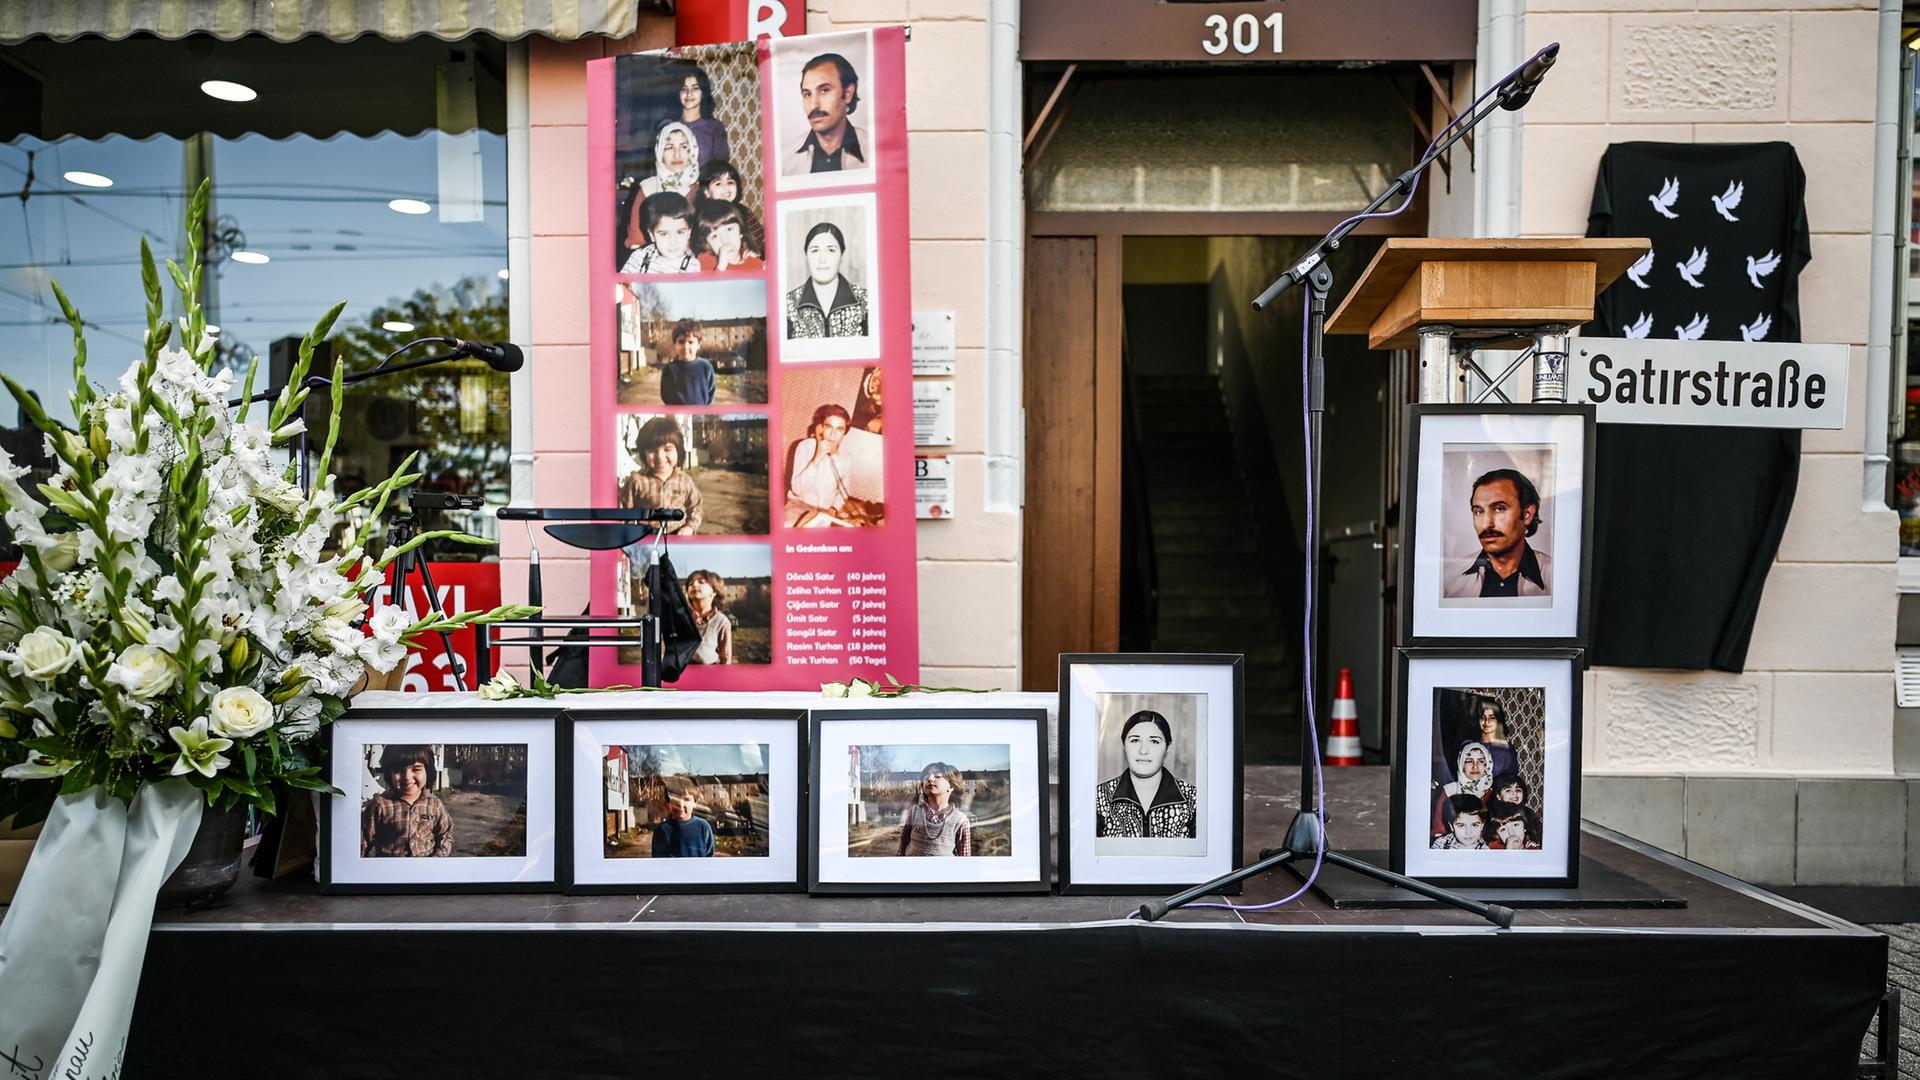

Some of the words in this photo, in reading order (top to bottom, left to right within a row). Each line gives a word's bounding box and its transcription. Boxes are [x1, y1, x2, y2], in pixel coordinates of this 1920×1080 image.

[1202, 12, 1284, 55] 301
[1587, 353, 1826, 410] Satırstraße
[785, 544, 795, 553] In
[796, 544, 838, 553] Gedenken
[838, 545, 853, 553] an:
[786, 572, 813, 580] Döndü
[847, 572, 860, 581] (40
[862, 572, 885, 581] Jahre)
[848, 587, 861, 595] (18
[862, 587, 886, 595] Jahre)
[852, 601, 860, 609] (7
[862, 601, 886, 609] Jahre)
[787, 613, 806, 622] Ümit
[853, 615, 861, 623] (5
[863, 615, 886, 623] Jahre)
[787, 629, 815, 638] Songül
[852, 629, 861, 637] (4
[863, 629, 886, 637] Jahre)
[848, 643, 860, 651] (18
[863, 643, 886, 651] Jahre)
[849, 657, 862, 665] (50
[864, 657, 886, 665] Tage)
